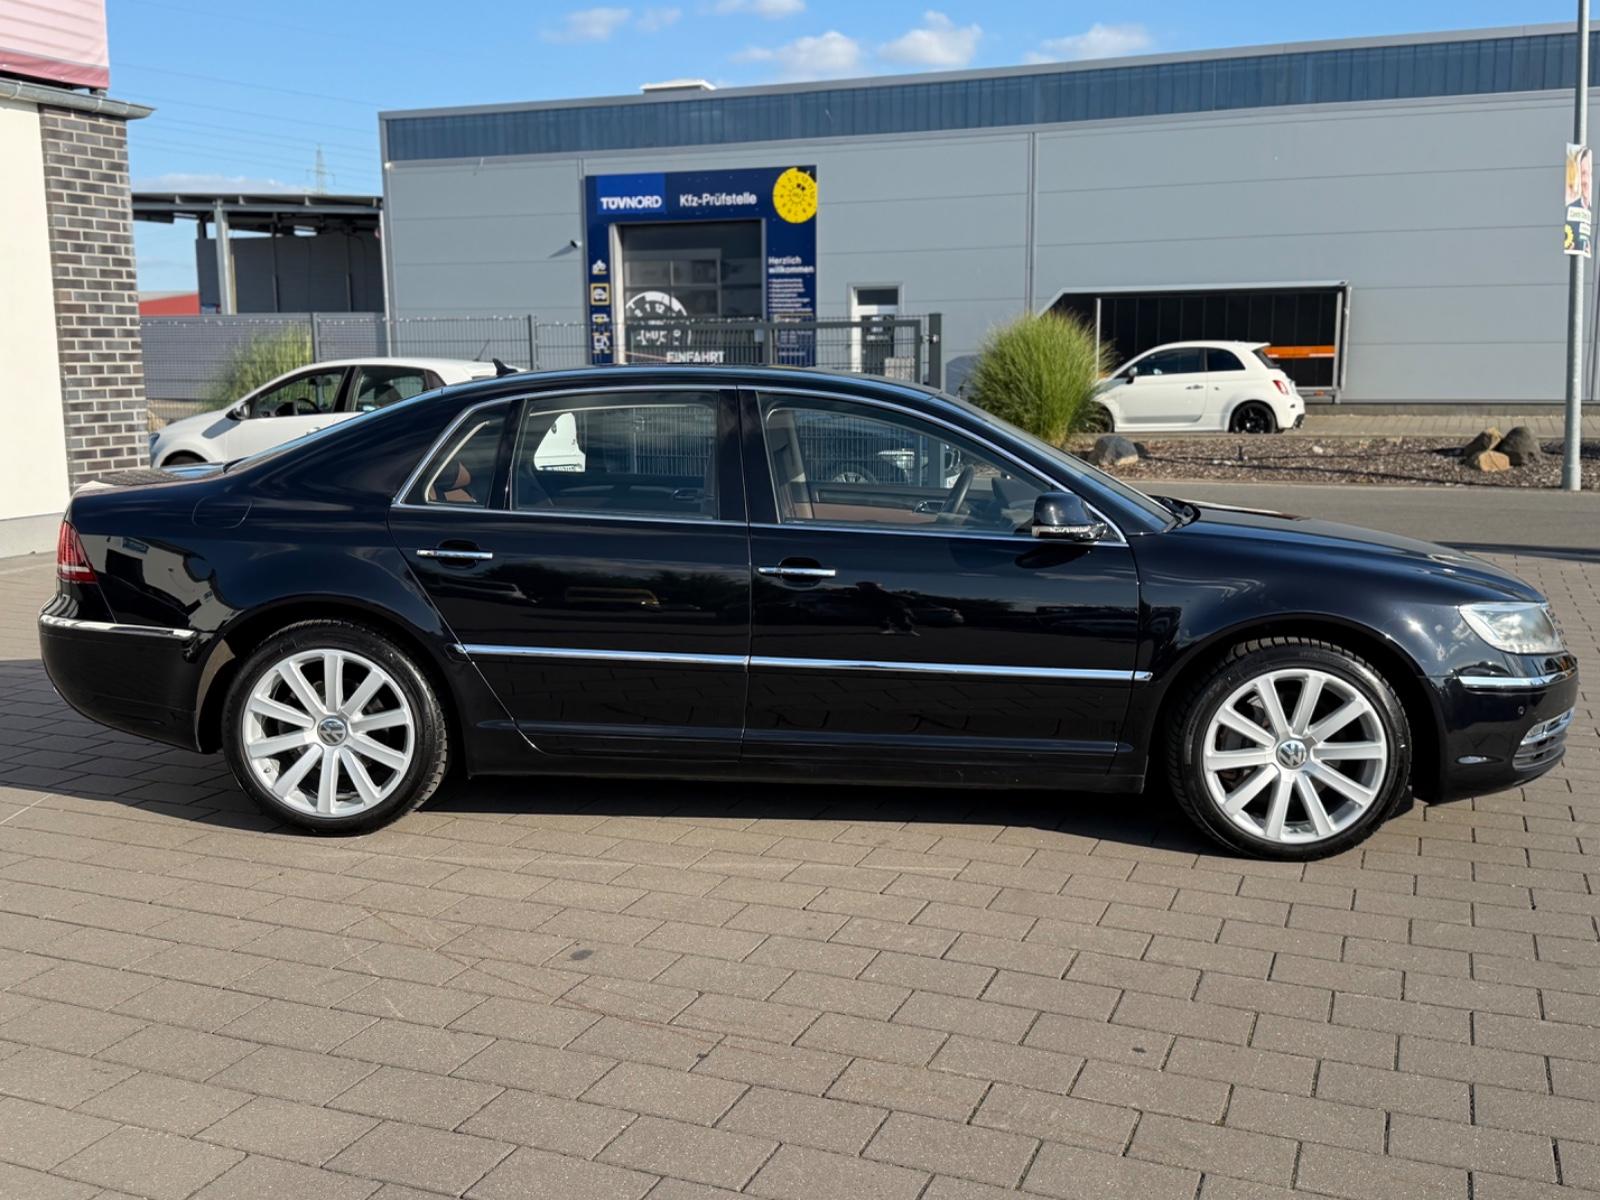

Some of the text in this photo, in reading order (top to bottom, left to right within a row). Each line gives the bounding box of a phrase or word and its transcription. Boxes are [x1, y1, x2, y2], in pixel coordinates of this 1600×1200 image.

[680, 192, 757, 207] Kfz-Prüfstelle
[768, 256, 802, 265] Herzlich
[768, 266, 815, 274] willkommen
[666, 351, 725, 363] EINFAHRT
